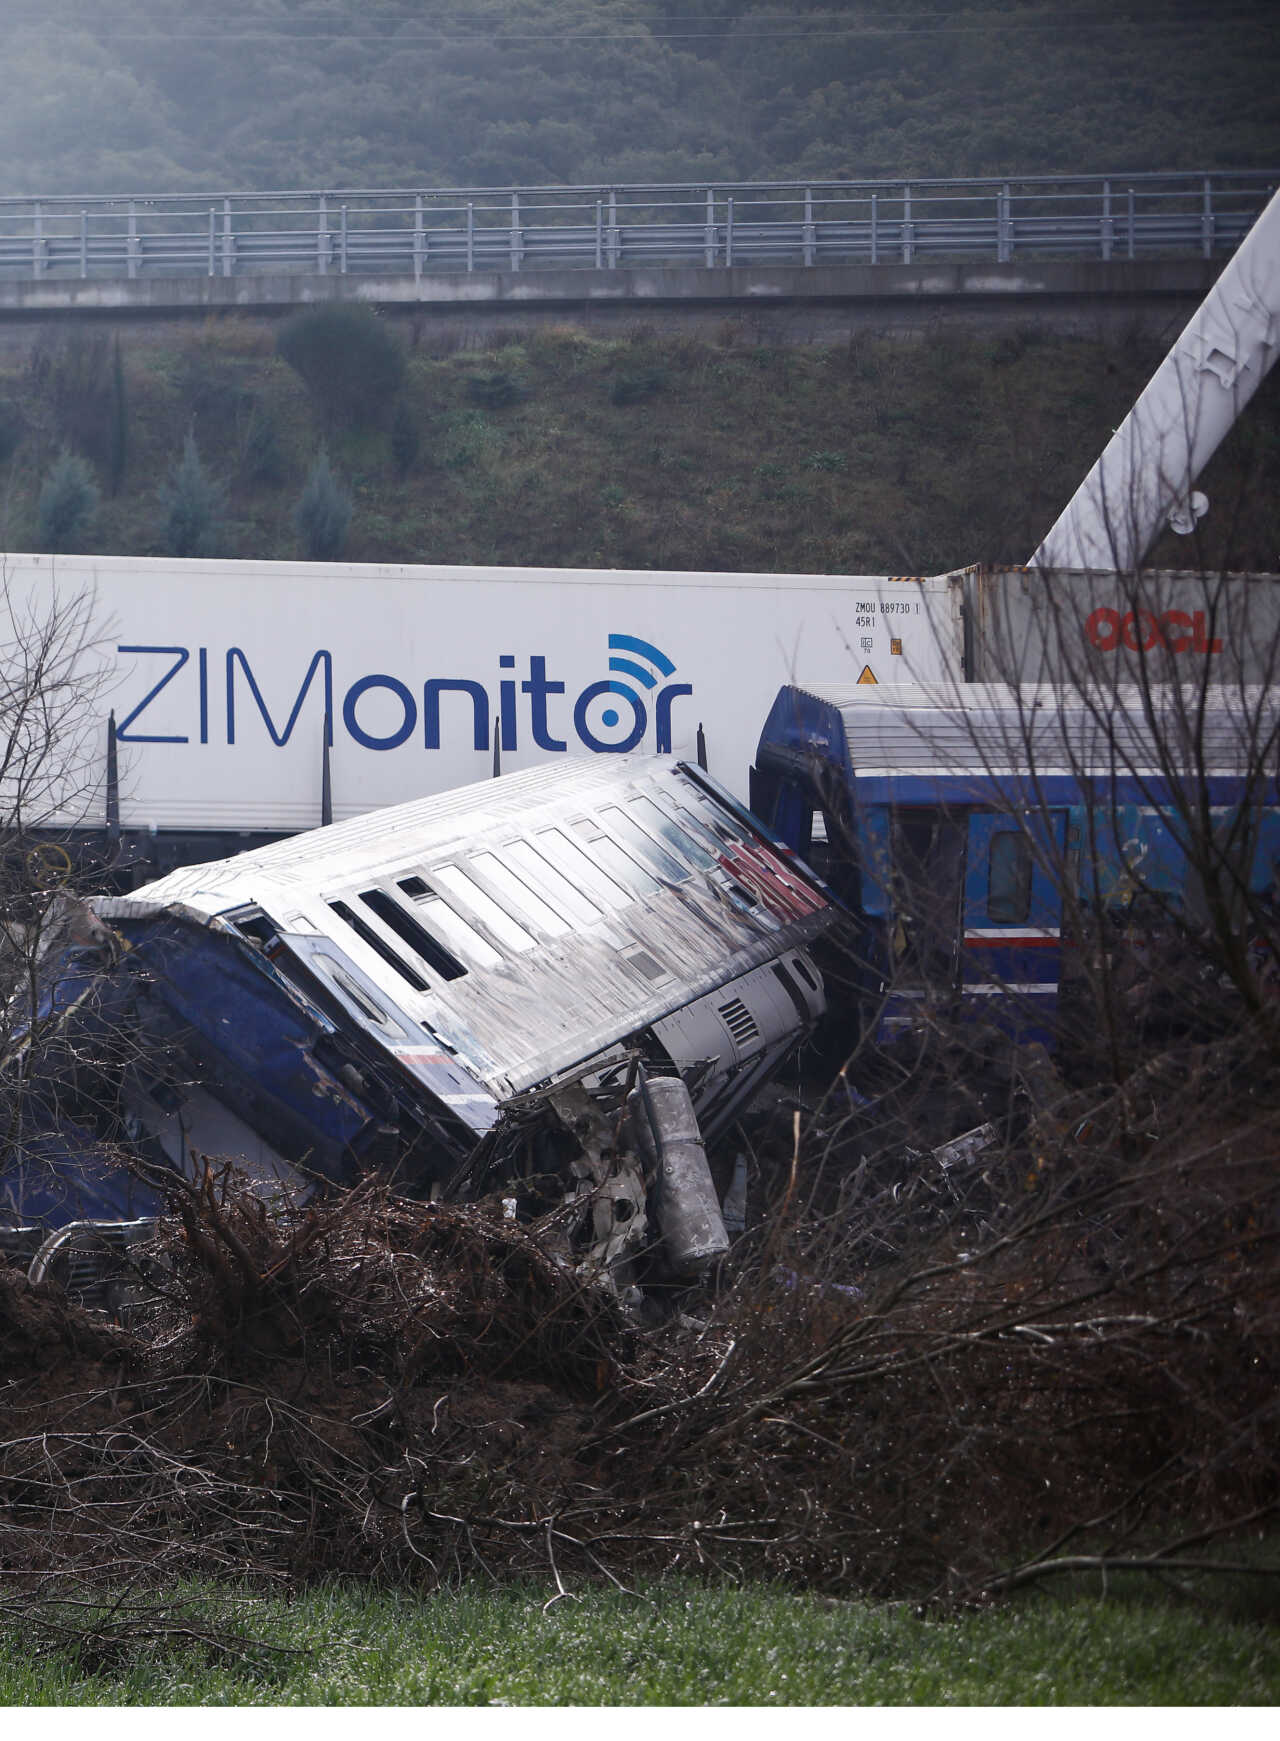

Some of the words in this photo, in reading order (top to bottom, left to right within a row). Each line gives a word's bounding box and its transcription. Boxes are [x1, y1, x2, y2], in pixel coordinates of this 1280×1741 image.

[855, 602, 876, 613] ZMOU
[880, 602, 910, 614] 889730
[855, 616, 875, 627] 45R1
[1085, 607, 1223, 653] OOCL
[116, 645, 692, 753] ZIMonitor
